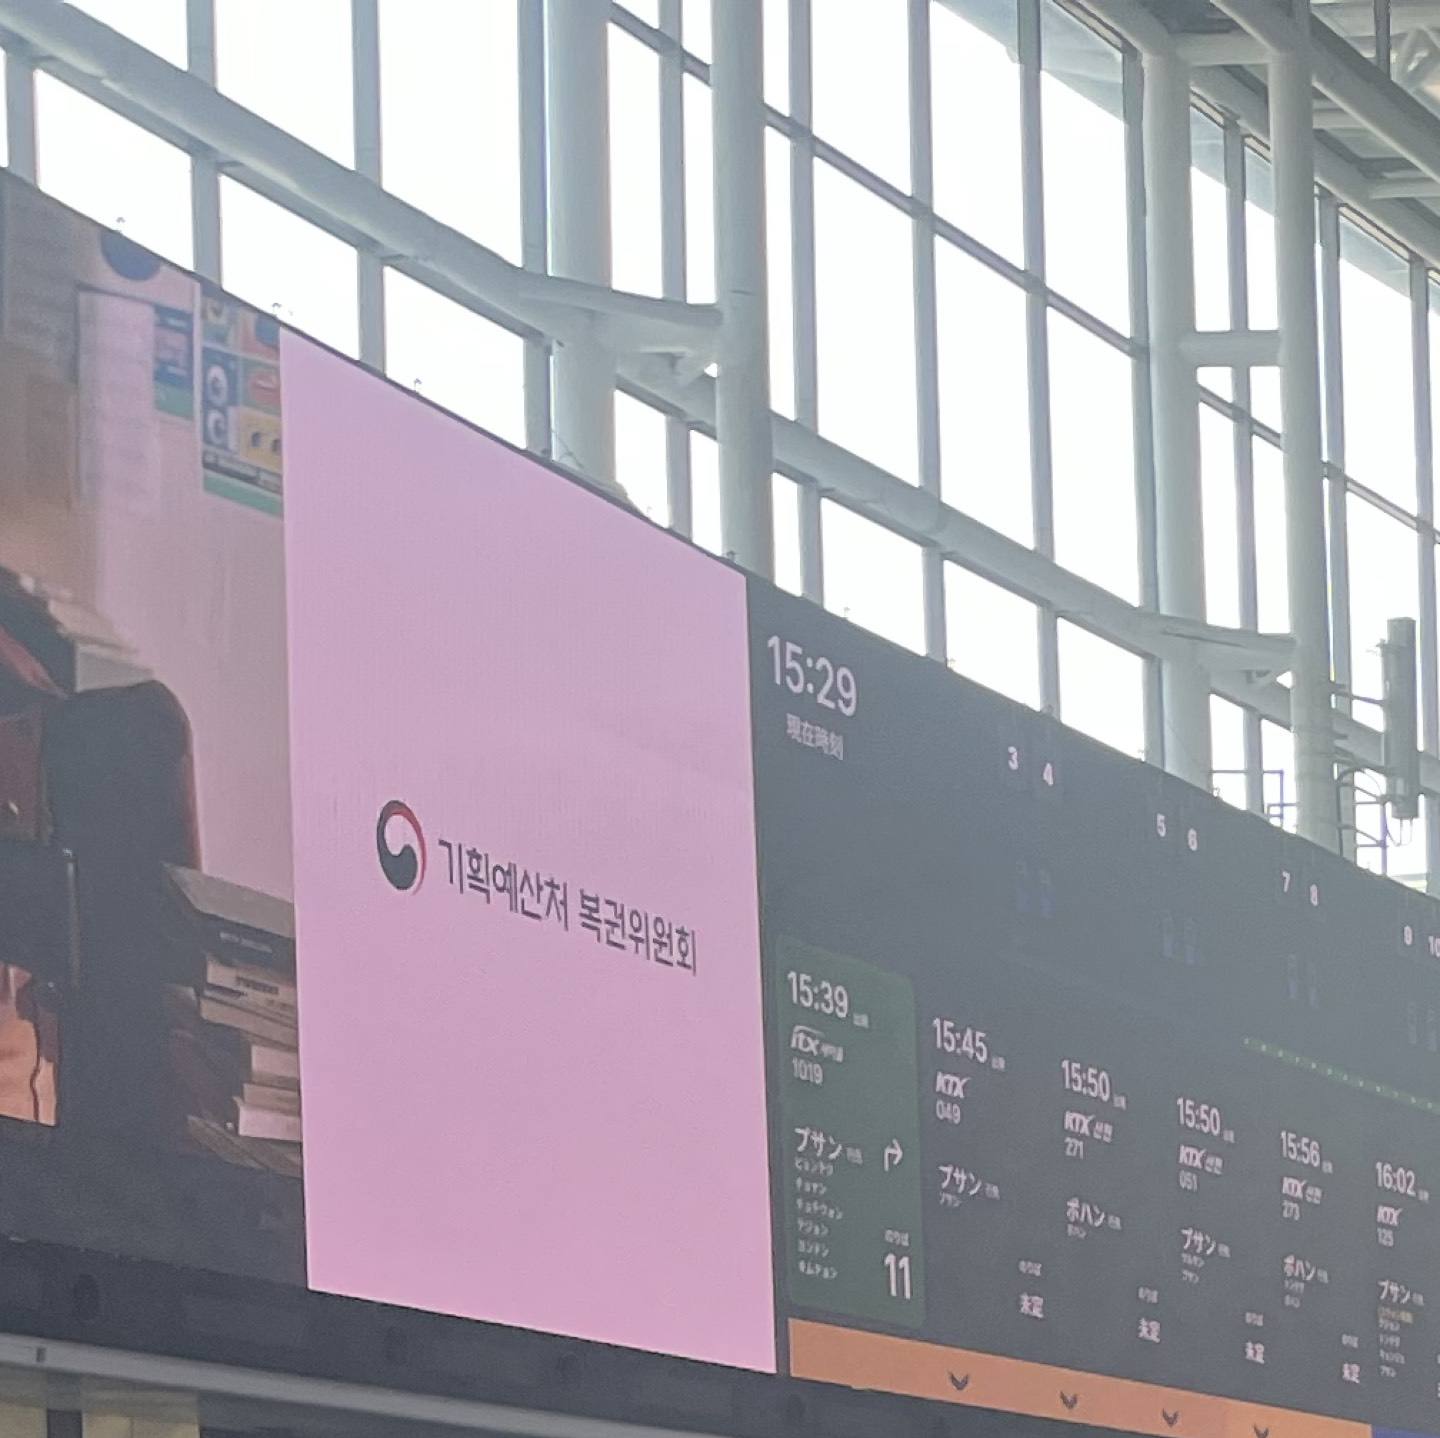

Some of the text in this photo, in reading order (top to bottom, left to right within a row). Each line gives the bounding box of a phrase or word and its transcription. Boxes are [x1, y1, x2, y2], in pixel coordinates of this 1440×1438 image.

[767, 635, 857, 717] 15:29
[1008, 746, 1019, 770] 3
[1042, 763, 1054, 786] 4
[1156, 813, 1167, 837] 5
[1282, 870, 1291, 893] 7
[437, 838, 697, 976] 기획예산처 복권위원회
[787, 970, 849, 1019] 15:39
[933, 1017, 988, 1063] 15:45
[792, 1057, 823, 1085] 1019
[935, 1071, 972, 1099] KTX
[1061, 1059, 1110, 1102] 15:50
[1064, 1110, 1094, 1137] KTX
[1177, 1096, 1221, 1137] 15:50
[1179, 1144, 1206, 1170] KTX
[1280, 1130, 1321, 1168] 15:56
[1376, 1161, 1417, 1197] 16:02
[884, 1254, 912, 1300] 11
